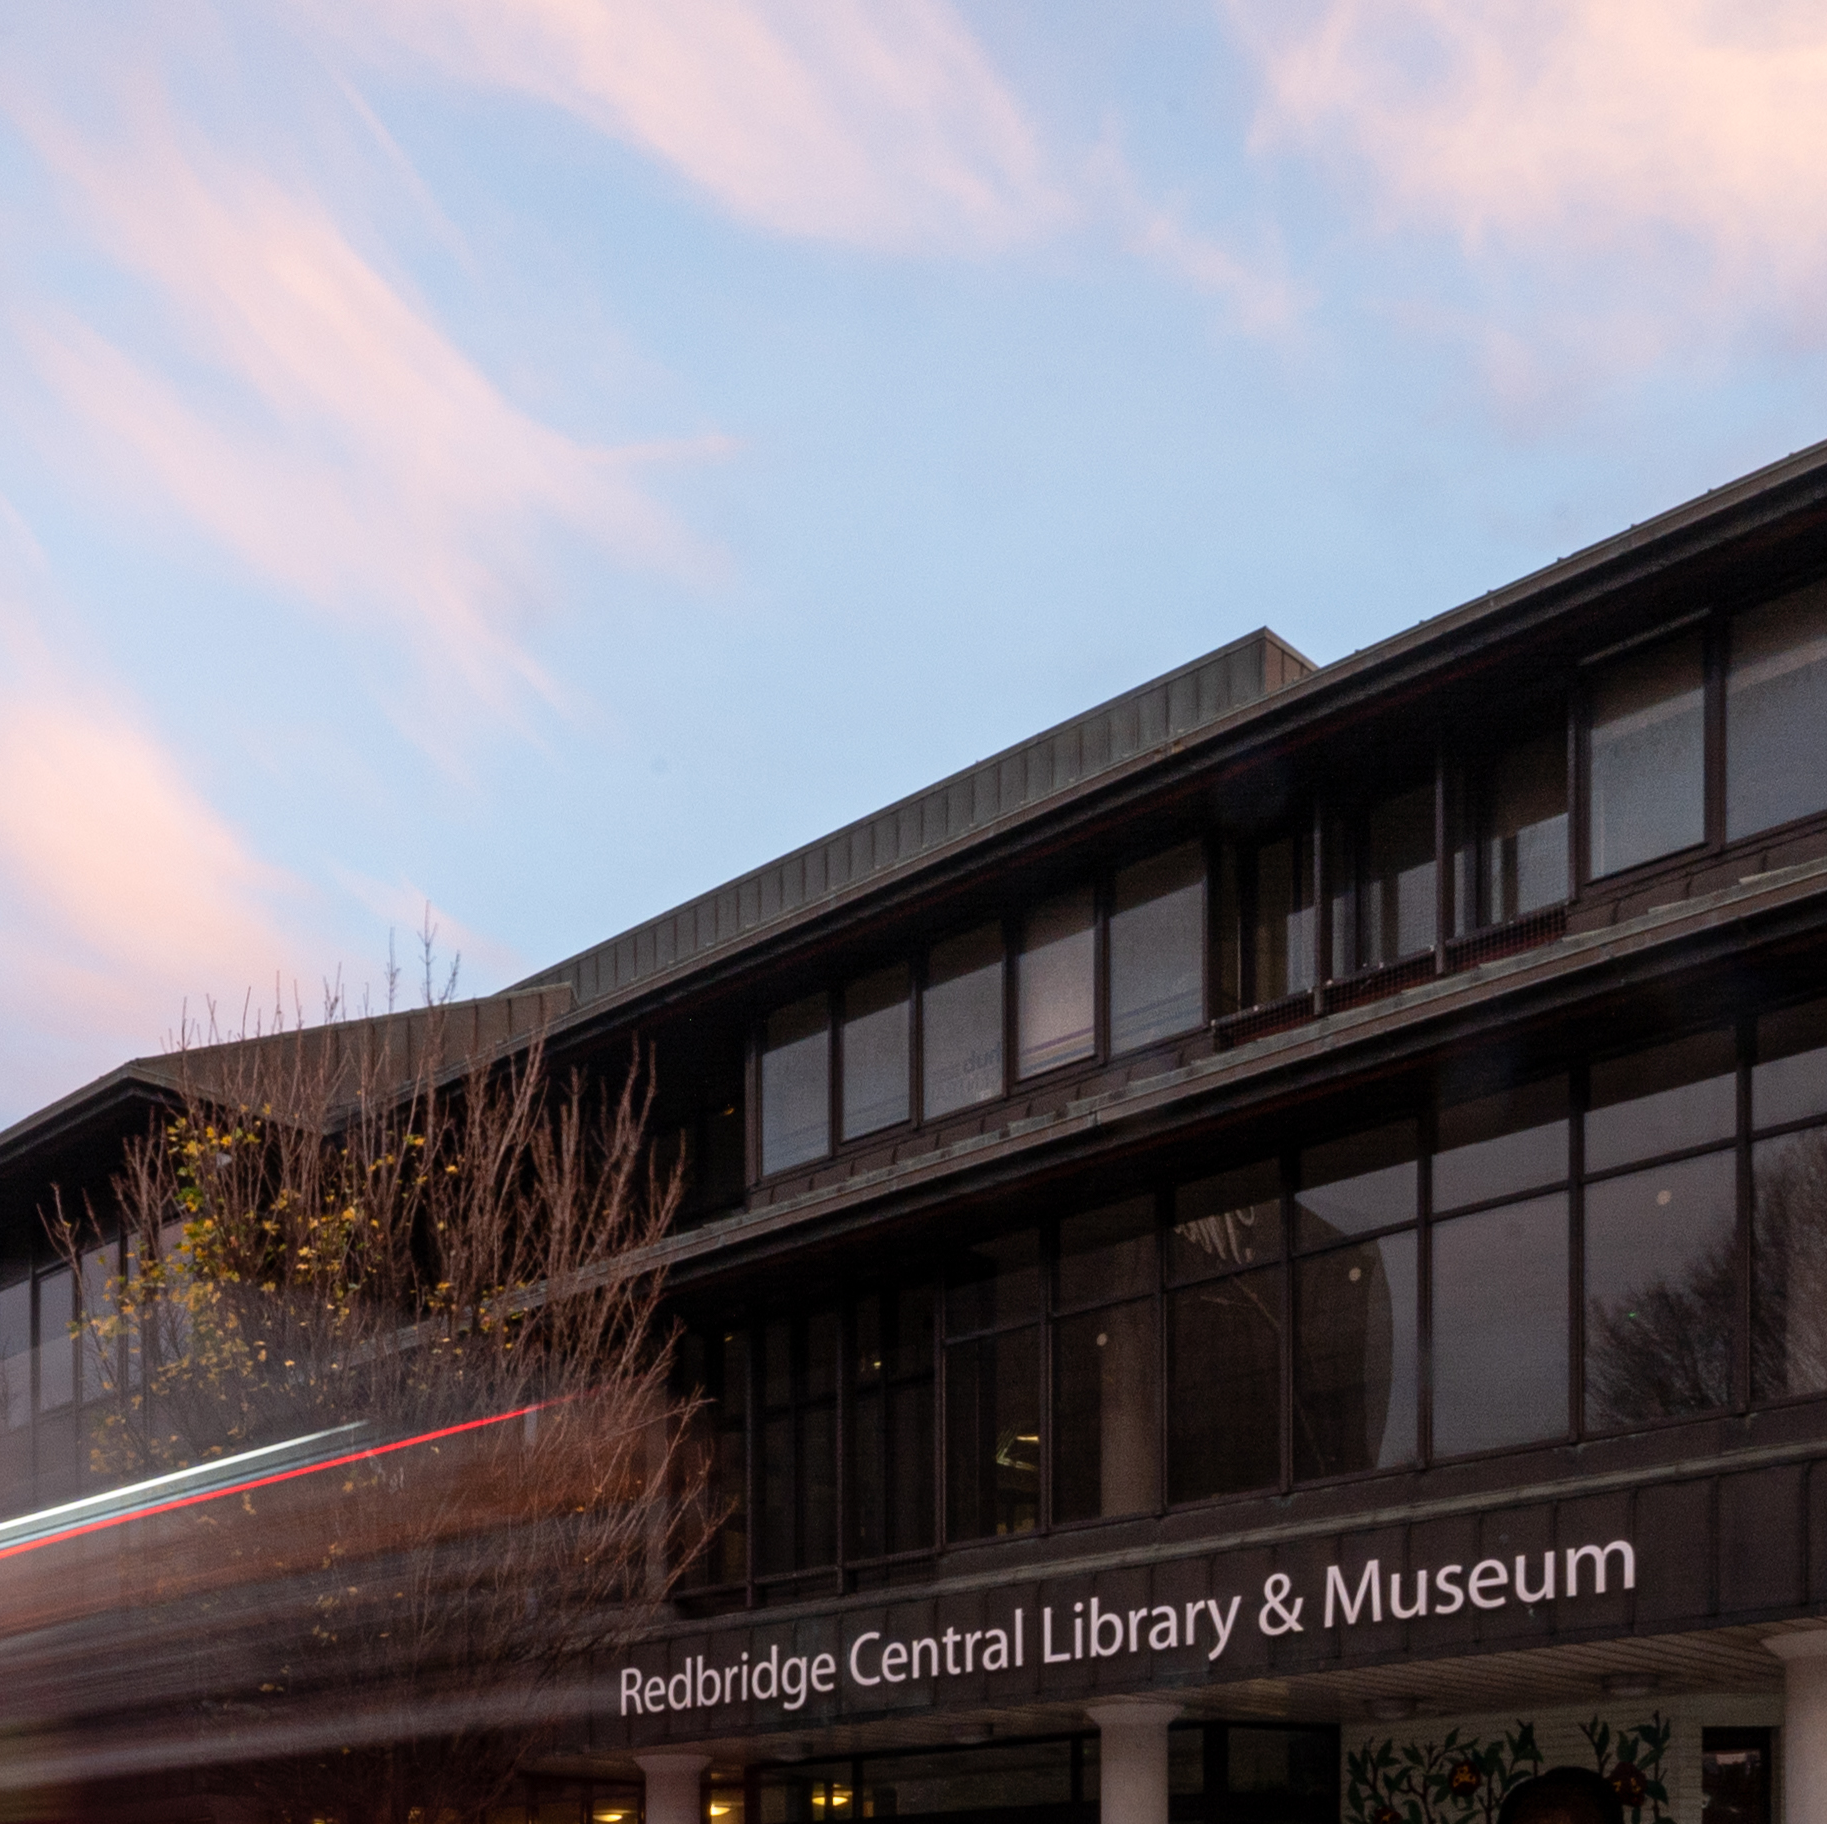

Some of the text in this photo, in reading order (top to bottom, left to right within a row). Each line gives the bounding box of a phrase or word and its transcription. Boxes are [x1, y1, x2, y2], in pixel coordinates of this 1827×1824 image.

[620, 1539, 1637, 1717] Redbridge Central Library & Museum
